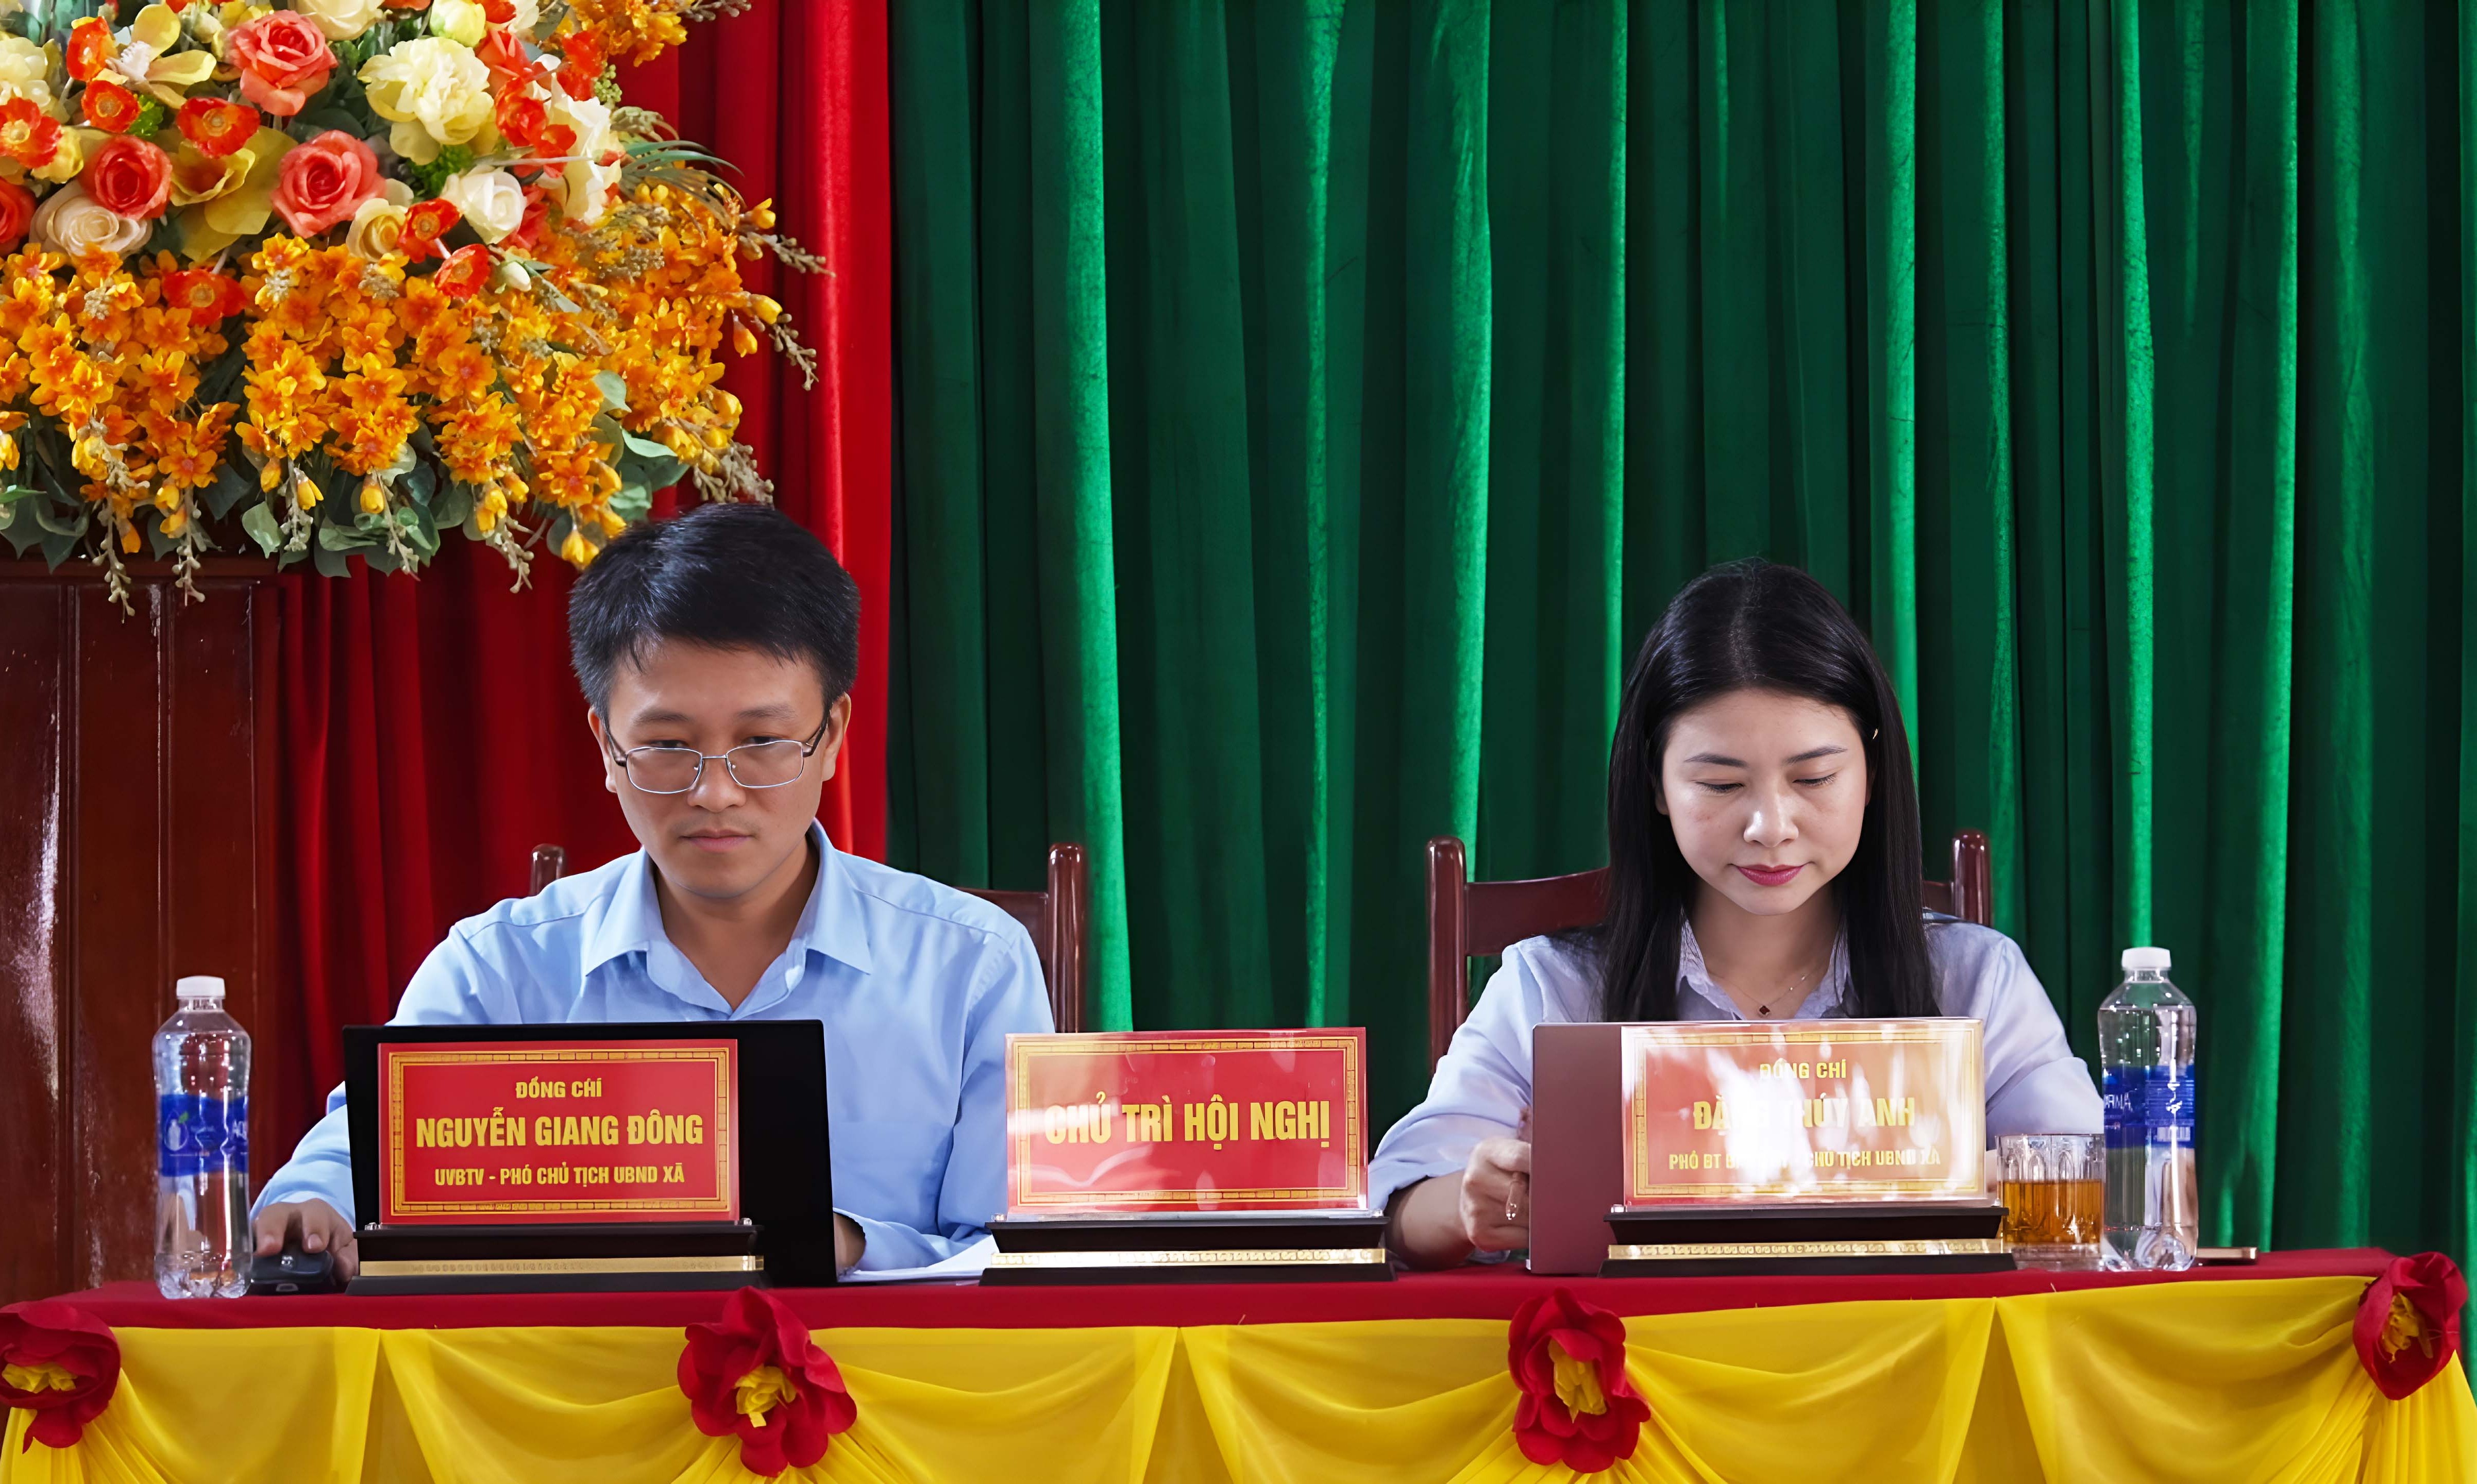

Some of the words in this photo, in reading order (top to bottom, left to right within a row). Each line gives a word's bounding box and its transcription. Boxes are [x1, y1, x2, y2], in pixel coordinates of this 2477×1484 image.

[1816, 1059, 1846, 1078] CHÍ
[571, 1077, 602, 1098] CHÍ
[1044, 1091, 1111, 1144] CHỦ
[1121, 1094, 1173, 1142] TRÌ
[1184, 1093, 1239, 1151] HỘI
[1250, 1100, 1330, 1148] NGHỊ
[1857, 1097, 1915, 1127] ANH
[416, 1107, 526, 1148] NGUYỄN
[535, 1115, 619, 1146] GIANG
[627, 1108, 703, 1144] ĐÔNG
[1669, 1150, 1699, 1170] PHÓ
[1703, 1154, 1722, 1169] BT
[435, 1168, 484, 1186] UVBTV
[500, 1164, 532, 1185] PHÓ
[537, 1162, 569, 1185] CHỦ
[573, 1167, 609, 1187] TỊCH
[614, 1166, 658, 1184] UBND
[663, 1162, 685, 1183] XÃ
